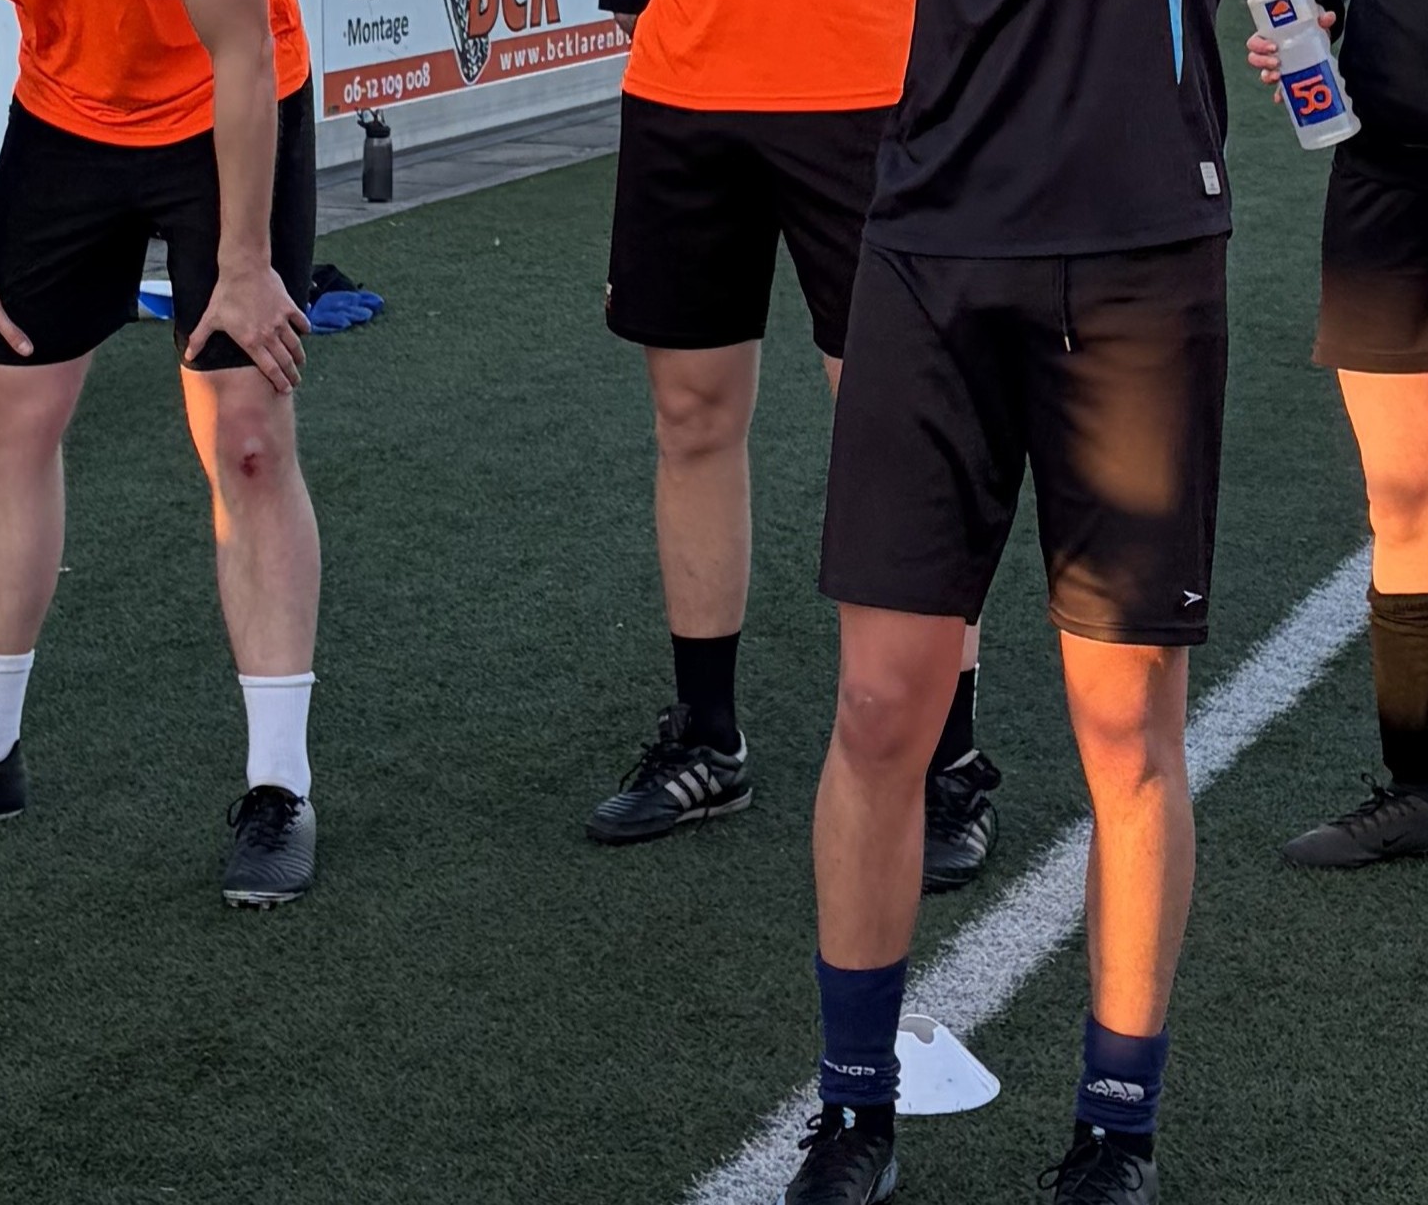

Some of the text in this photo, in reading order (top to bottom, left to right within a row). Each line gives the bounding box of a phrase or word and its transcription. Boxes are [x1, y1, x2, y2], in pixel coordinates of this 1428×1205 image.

[343, 61, 431, 104] 06-12 109 008
